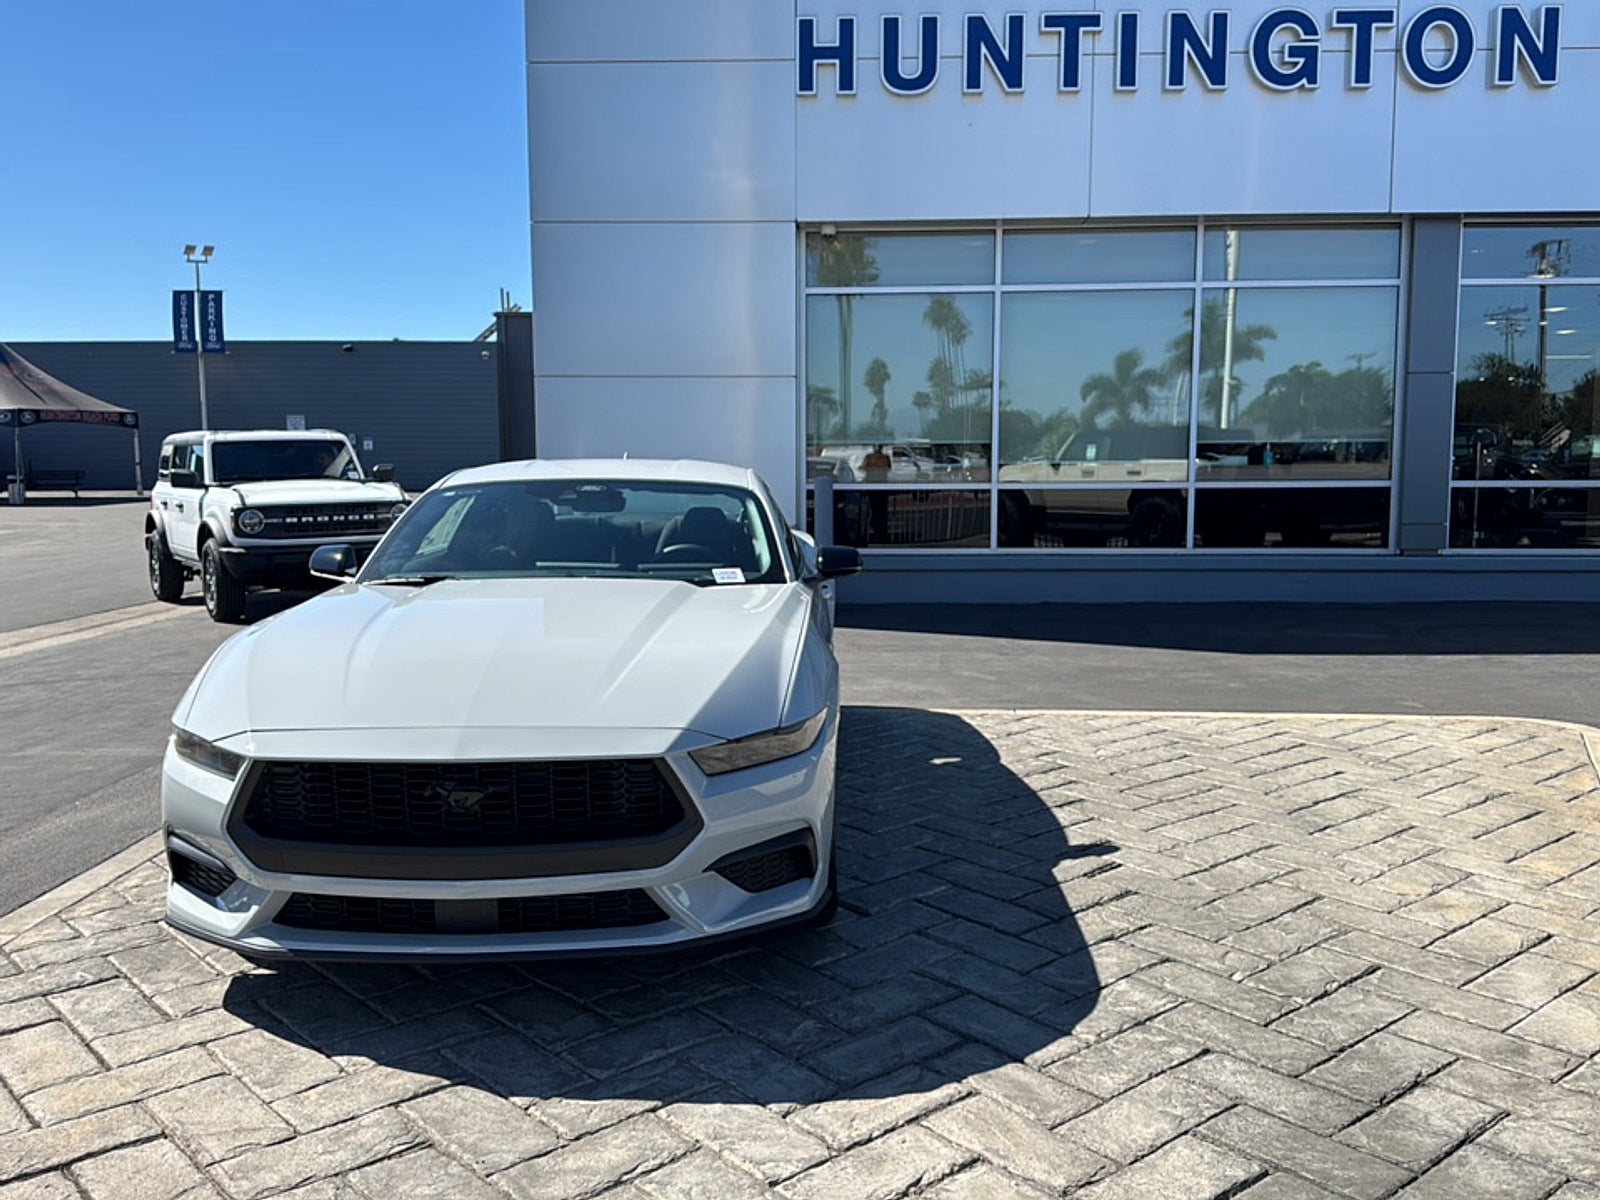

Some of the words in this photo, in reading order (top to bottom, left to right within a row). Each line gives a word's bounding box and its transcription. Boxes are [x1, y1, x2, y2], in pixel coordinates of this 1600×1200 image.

[797, 4, 1562, 97] HUNTINGTON
[207, 293, 217, 341] PARKING
[285, 513, 375, 523] BRONCO
